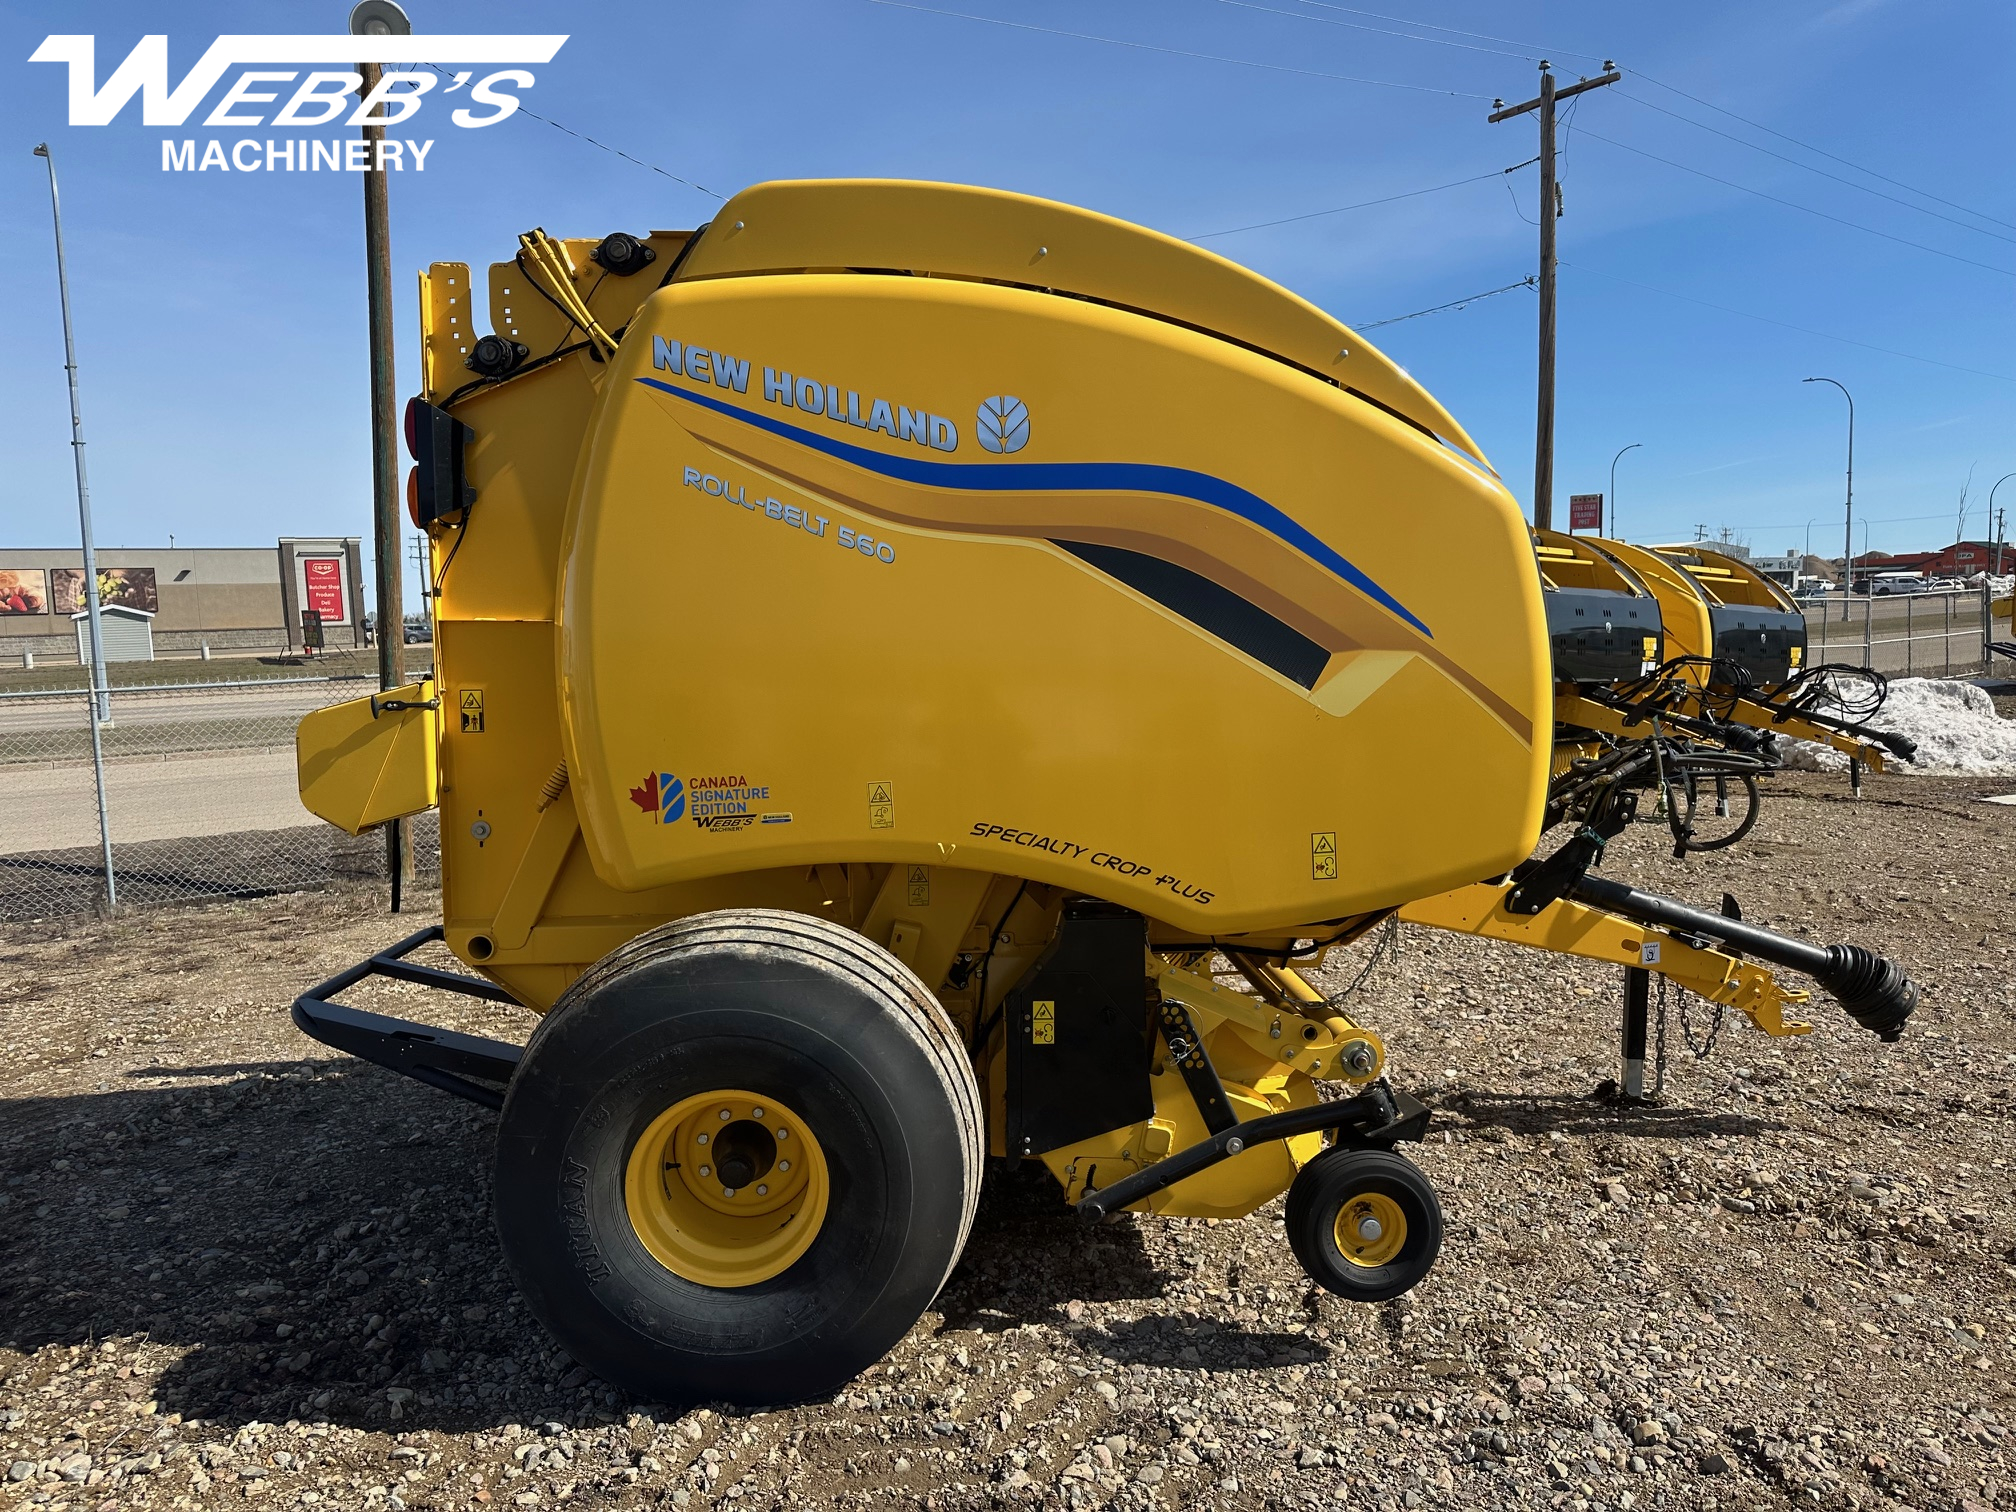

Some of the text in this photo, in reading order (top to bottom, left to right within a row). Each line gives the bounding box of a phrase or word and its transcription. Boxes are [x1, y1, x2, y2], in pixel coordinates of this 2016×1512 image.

[652, 334, 959, 453] NEW HOLLAND
[683, 465, 896, 564] ROLL-BELT 560
[689, 775, 748, 789] CANADA
[690, 787, 770, 803] SIGNATURE
[691, 802, 747, 816] EDITION
[692, 813, 758, 828] WEBB'S
[969, 822, 1090, 859] SPECIALTY
[1090, 852, 1152, 878] CROP
